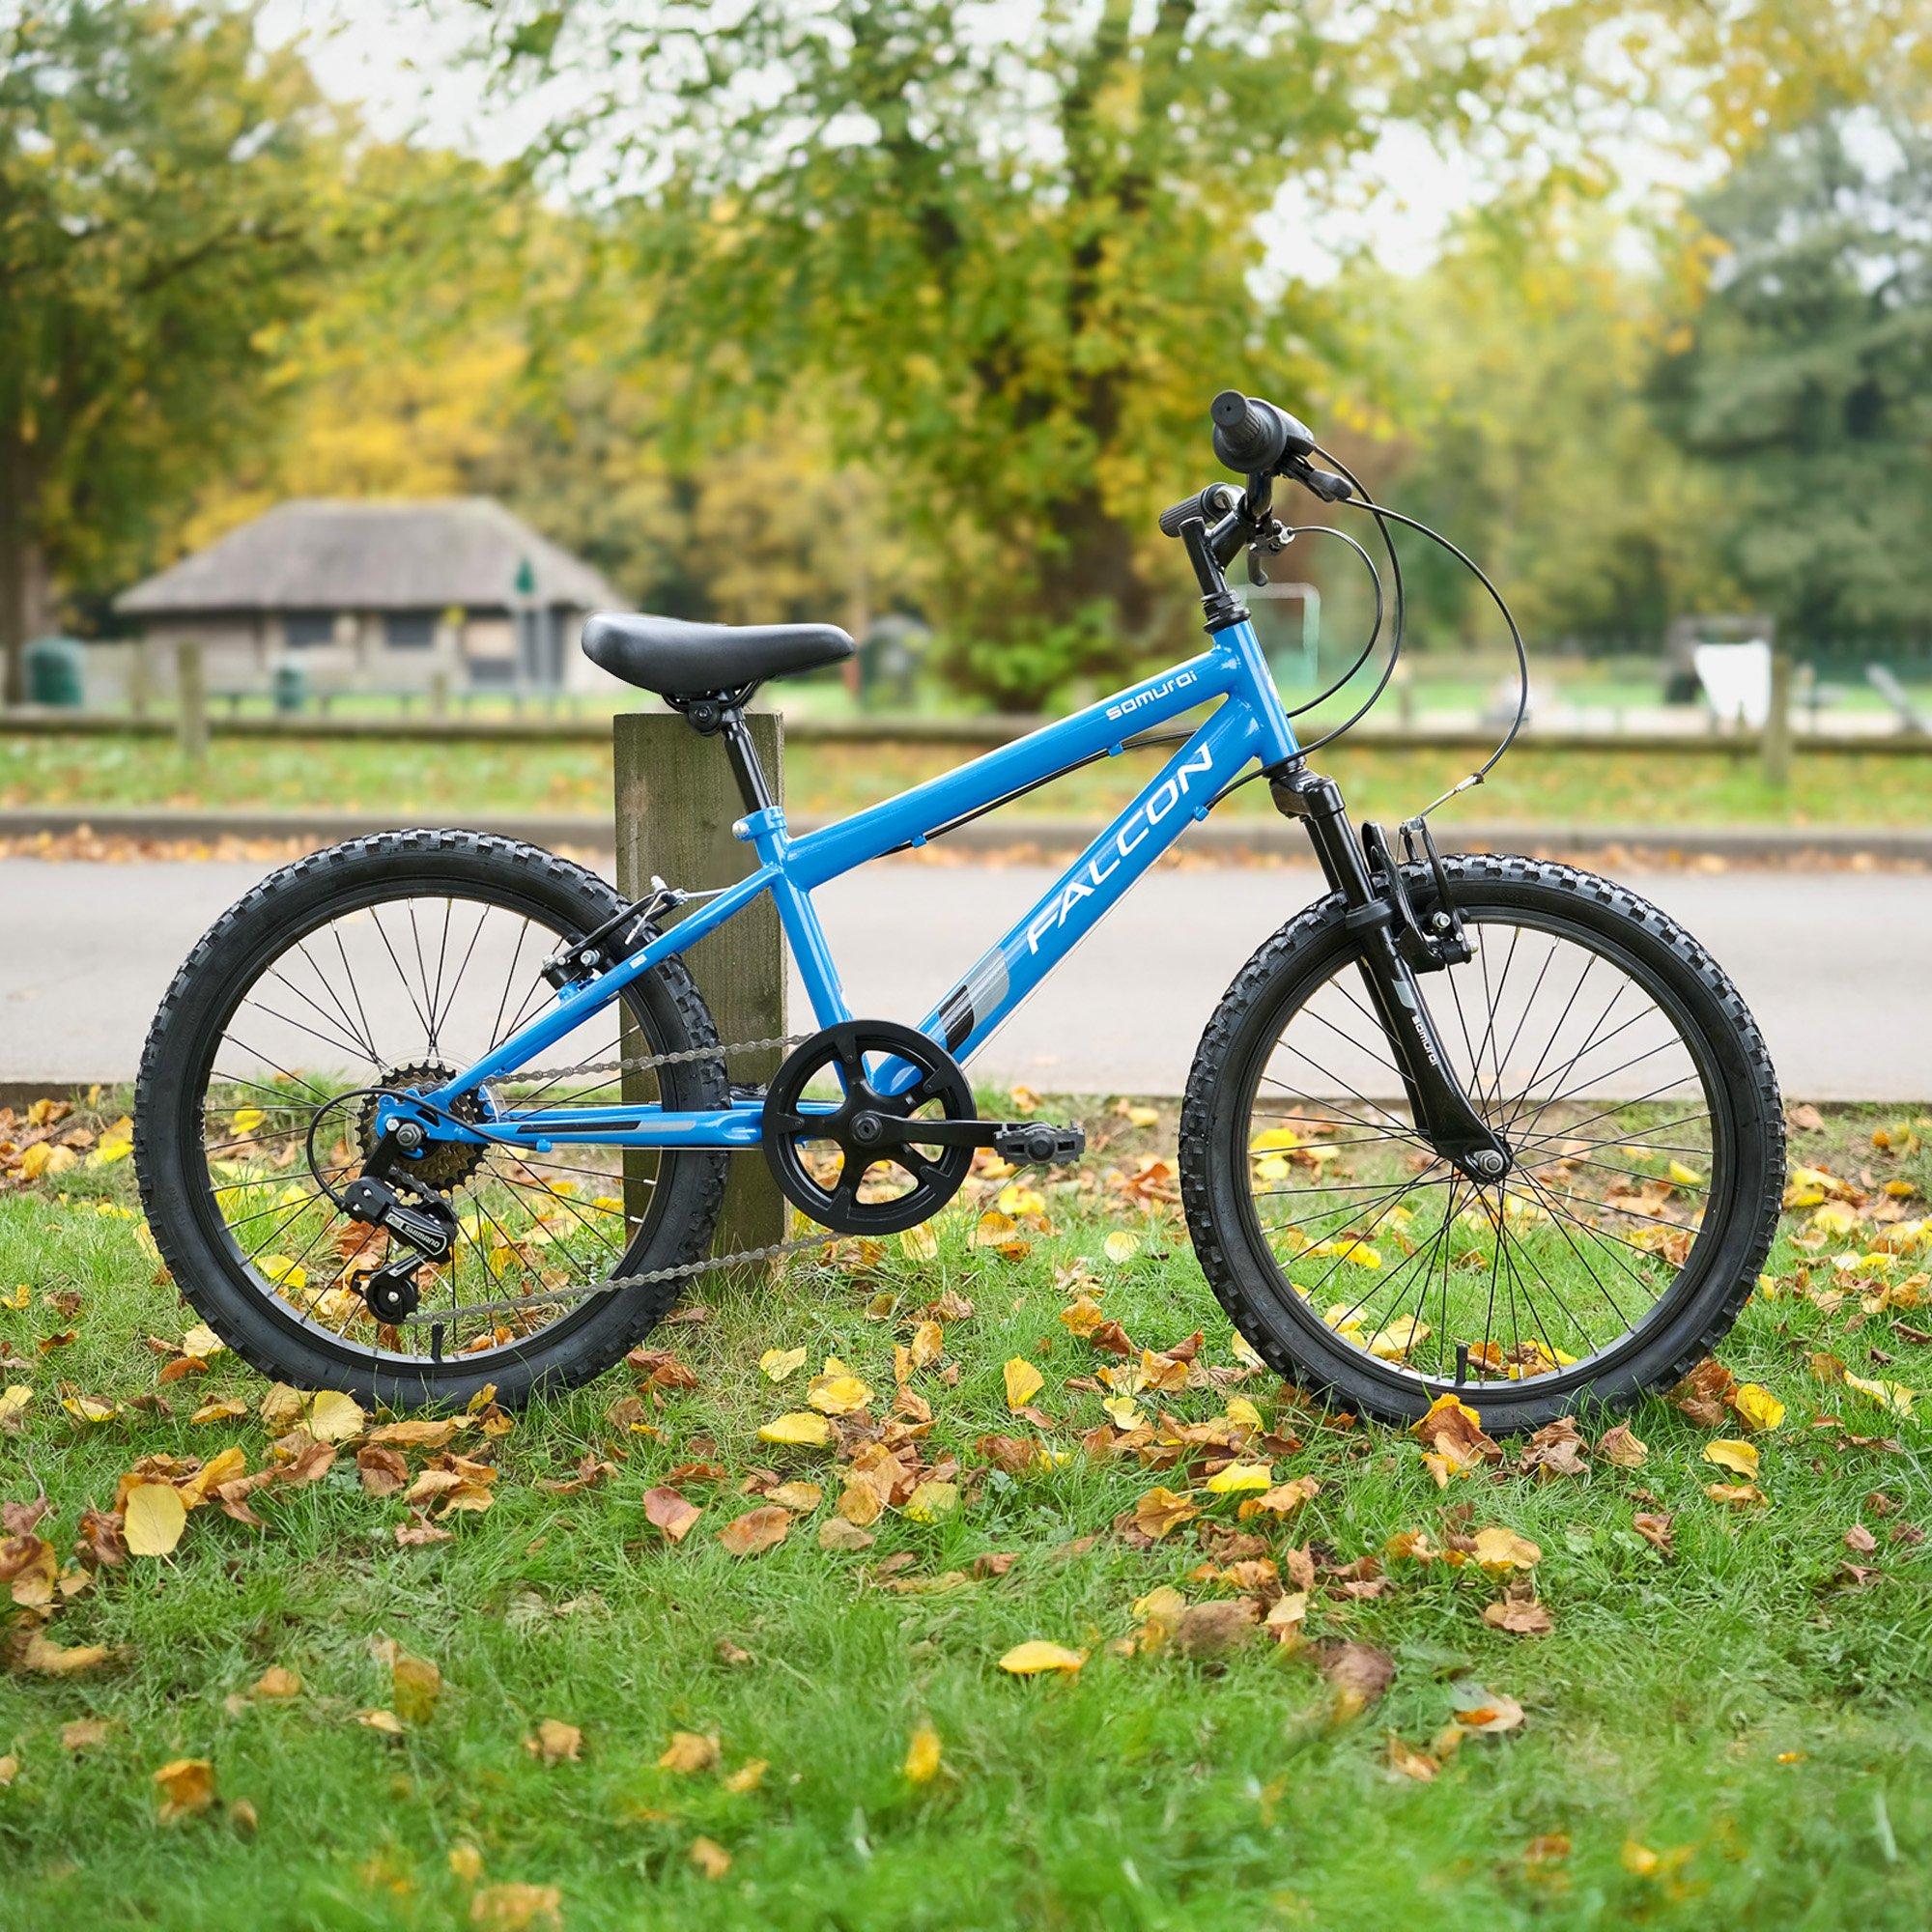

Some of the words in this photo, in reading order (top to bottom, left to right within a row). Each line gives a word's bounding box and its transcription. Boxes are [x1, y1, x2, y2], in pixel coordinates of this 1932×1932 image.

[1105, 669, 1198, 721] samurai
[1026, 741, 1213, 955] FALCON
[404, 1225, 440, 1248] SHIMANO
